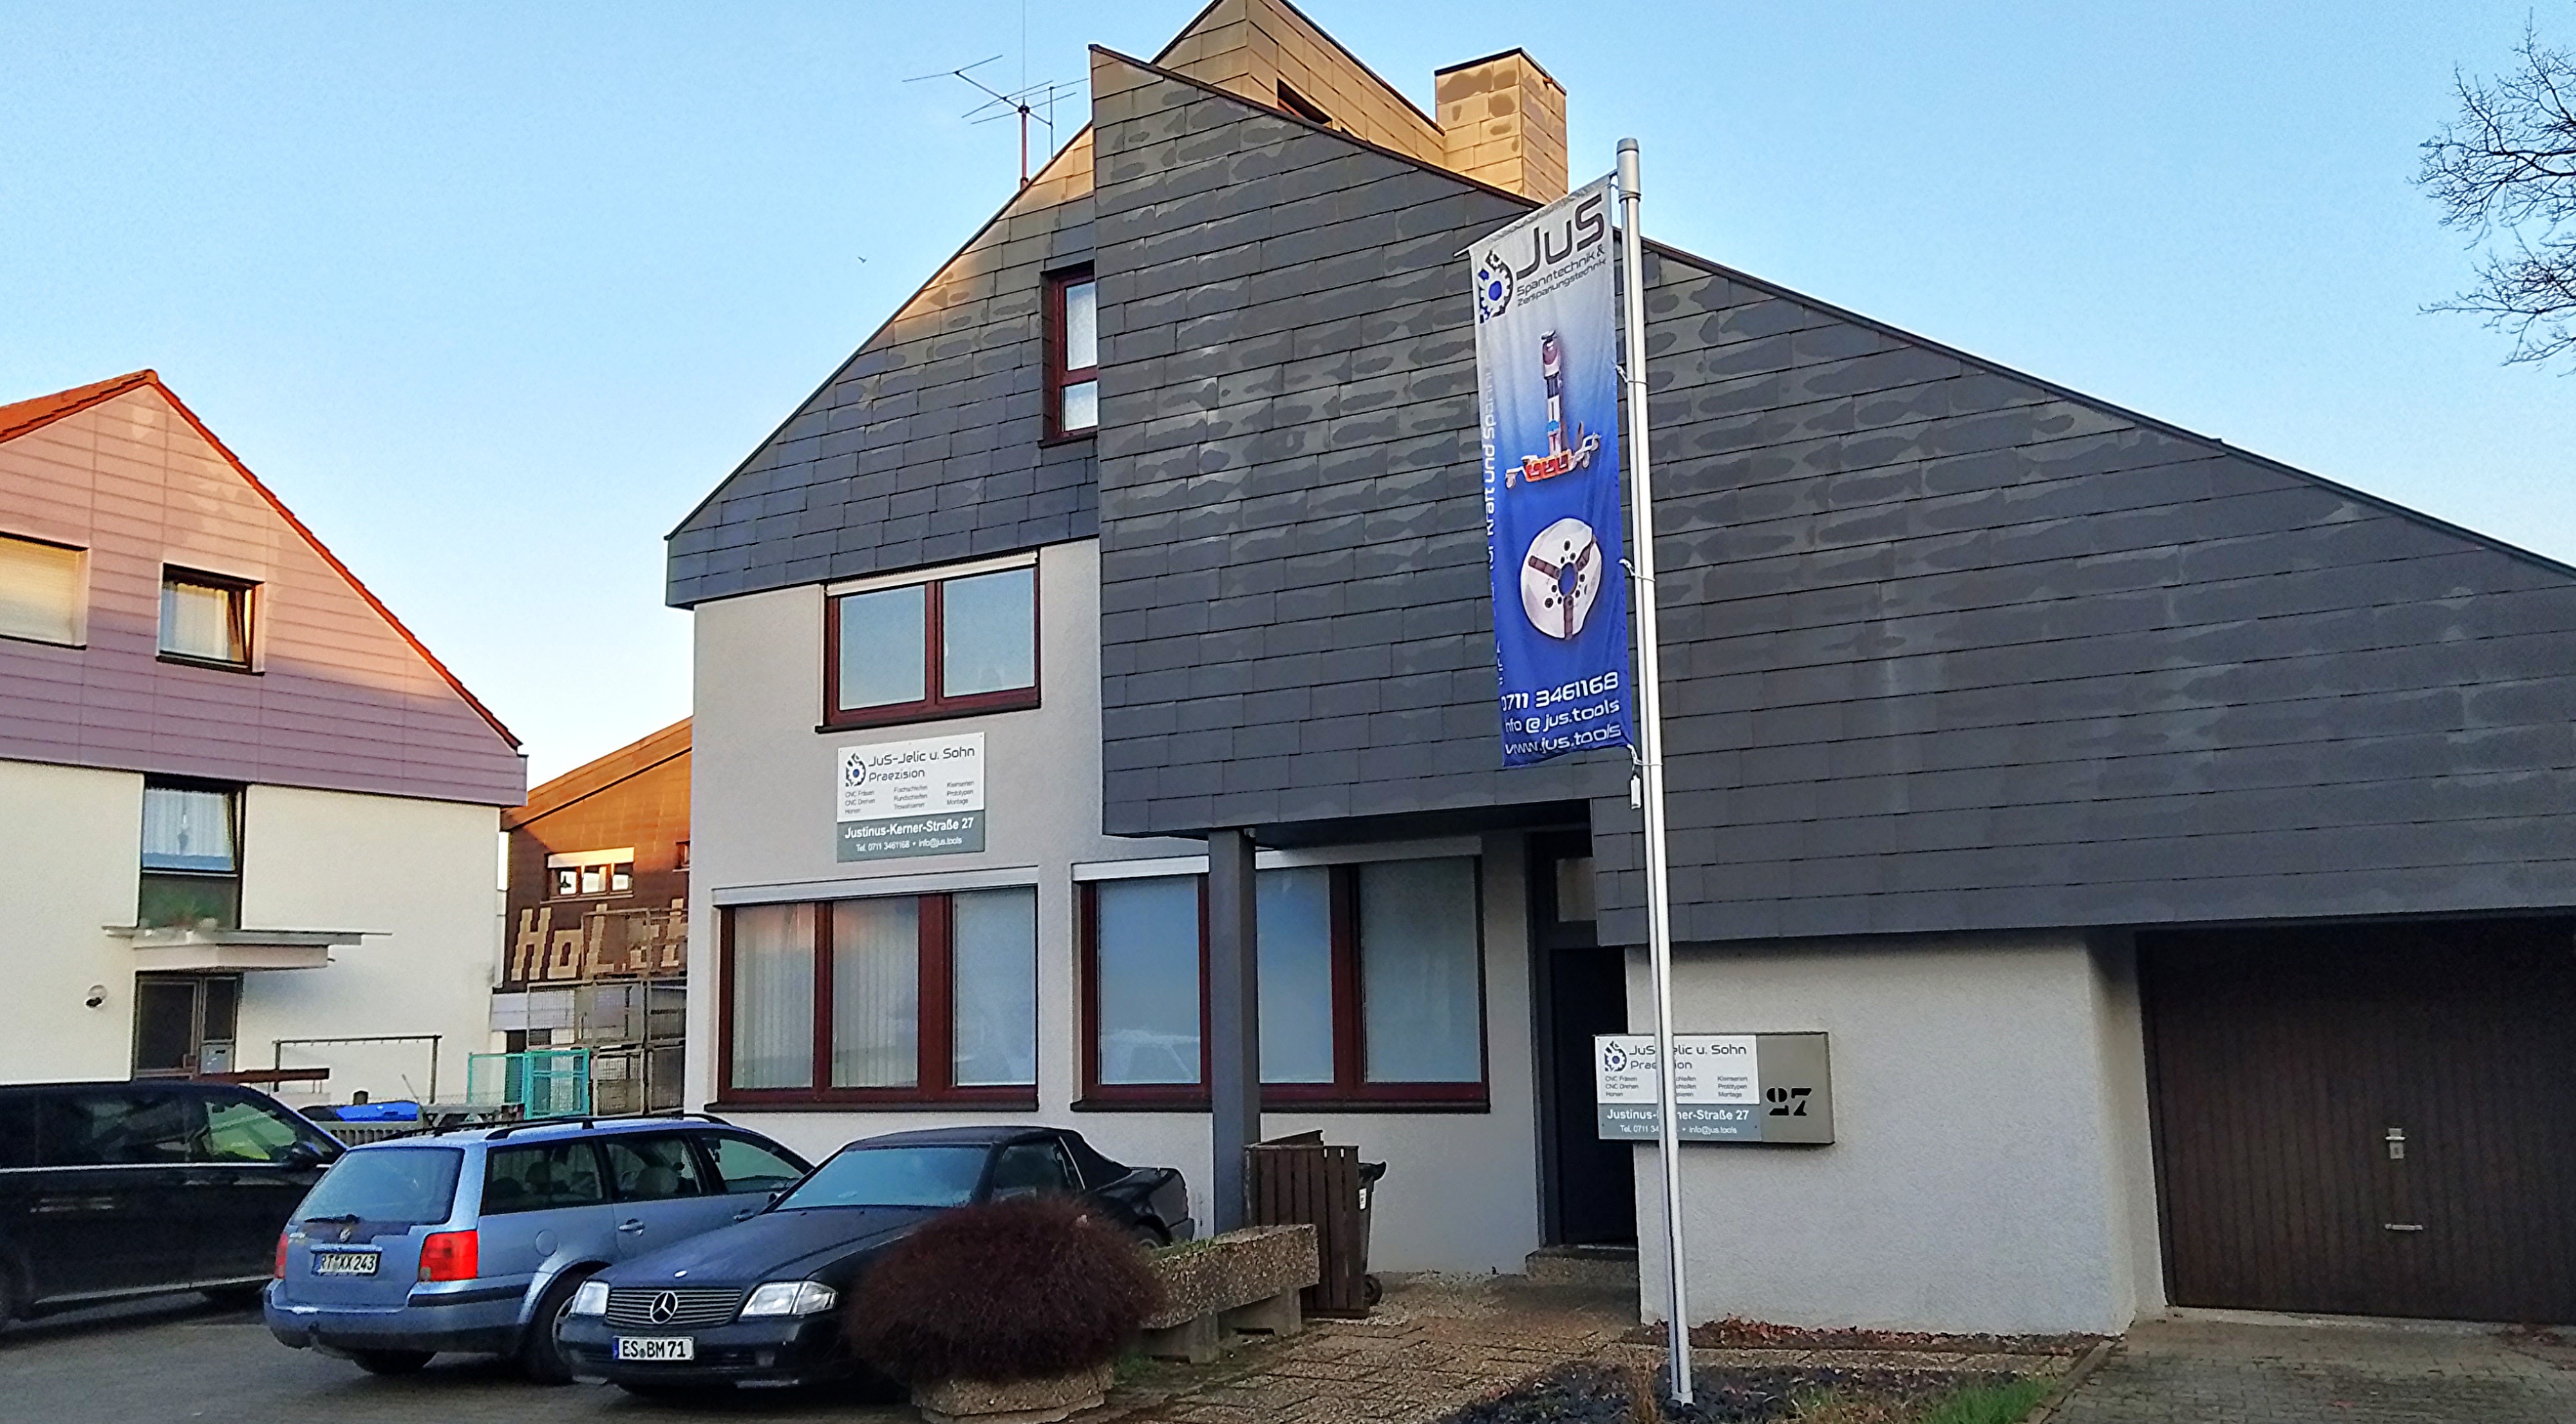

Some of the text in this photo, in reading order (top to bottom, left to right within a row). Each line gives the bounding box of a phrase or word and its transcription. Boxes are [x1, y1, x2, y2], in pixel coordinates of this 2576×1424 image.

[1517, 251, 1595, 297] Spanntechnik
[1483, 444, 1496, 483] und
[1536, 671, 1619, 708] 3461168
[1505, 717, 1522, 733] nfo
[1543, 699, 1620, 732] jus.tools
[868, 746, 975, 767] JuS-Jelic u. Sohn
[869, 769, 925, 782] Praezision
[844, 817, 974, 839] Justinus-Kerner-Straße 27
[868, 842, 882, 851] 0711
[1711, 1043, 1747, 1055] Sohn
[1736, 1110, 1749, 1120] 27
[353, 1256, 375, 1271] 243
[622, 1340, 686, 1358] ES BM 71
